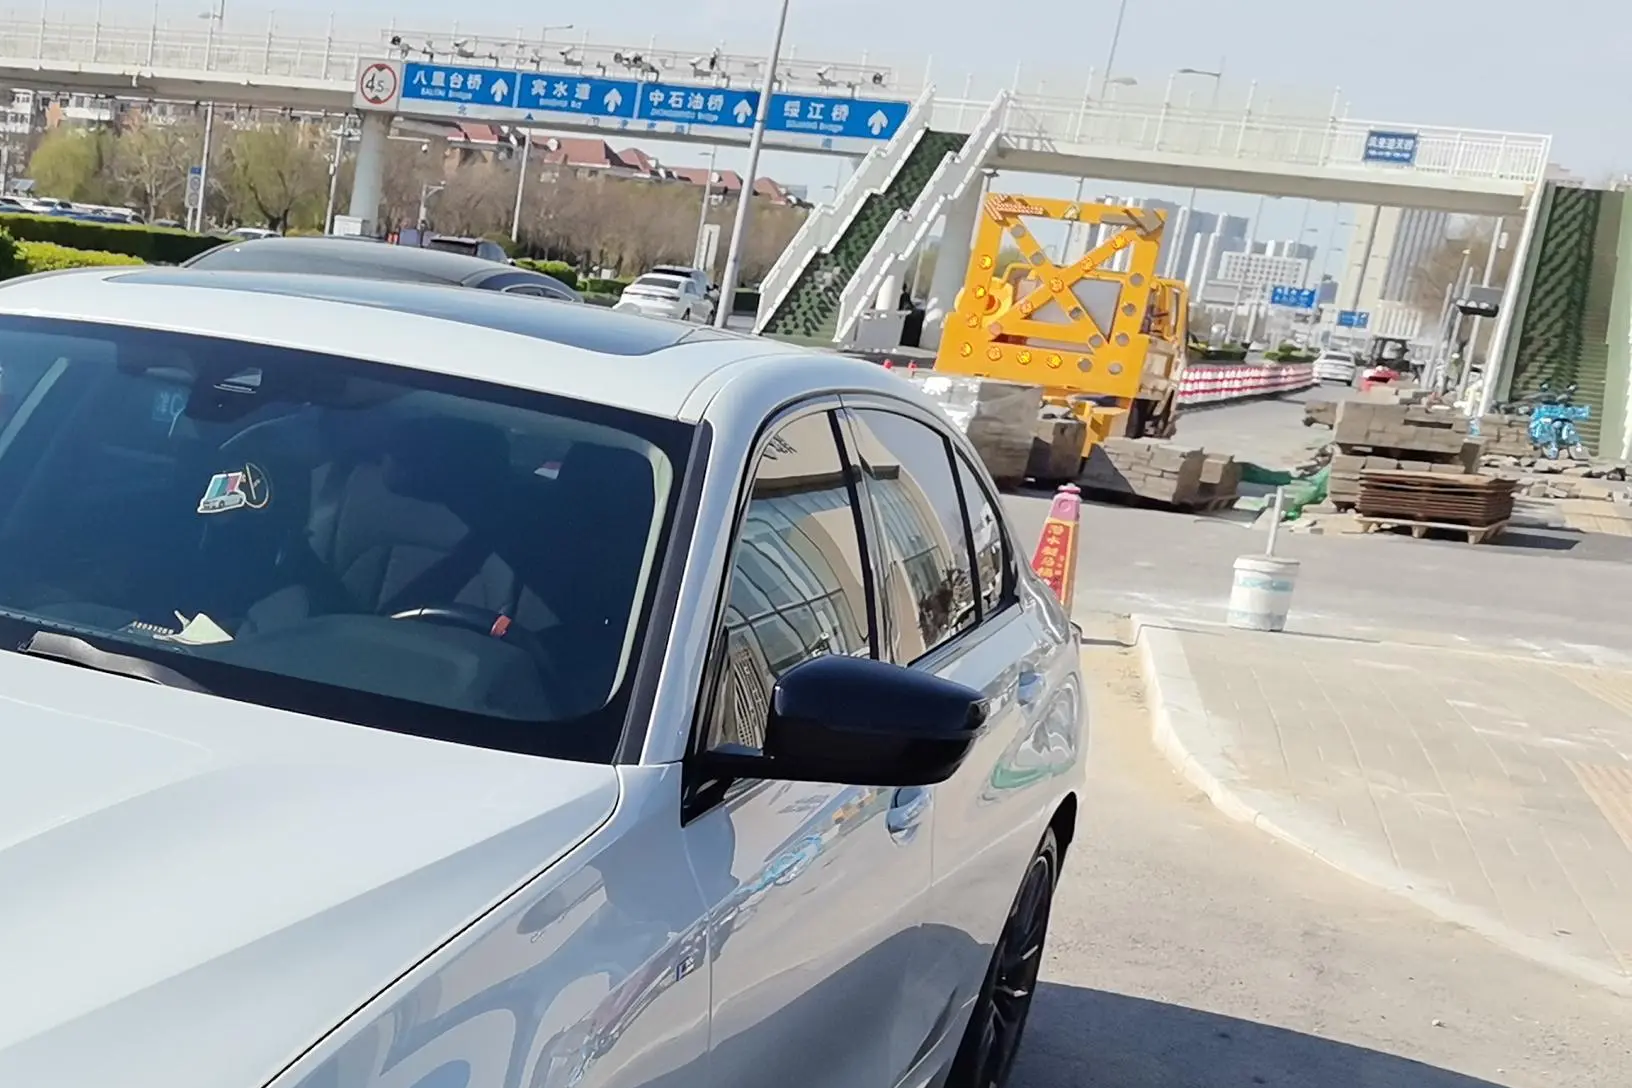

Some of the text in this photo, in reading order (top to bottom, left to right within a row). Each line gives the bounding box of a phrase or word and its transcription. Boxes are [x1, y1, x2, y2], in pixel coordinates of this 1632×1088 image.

[412, 70, 482, 91] 八里台桥
[649, 88, 724, 111] 中石油桥
